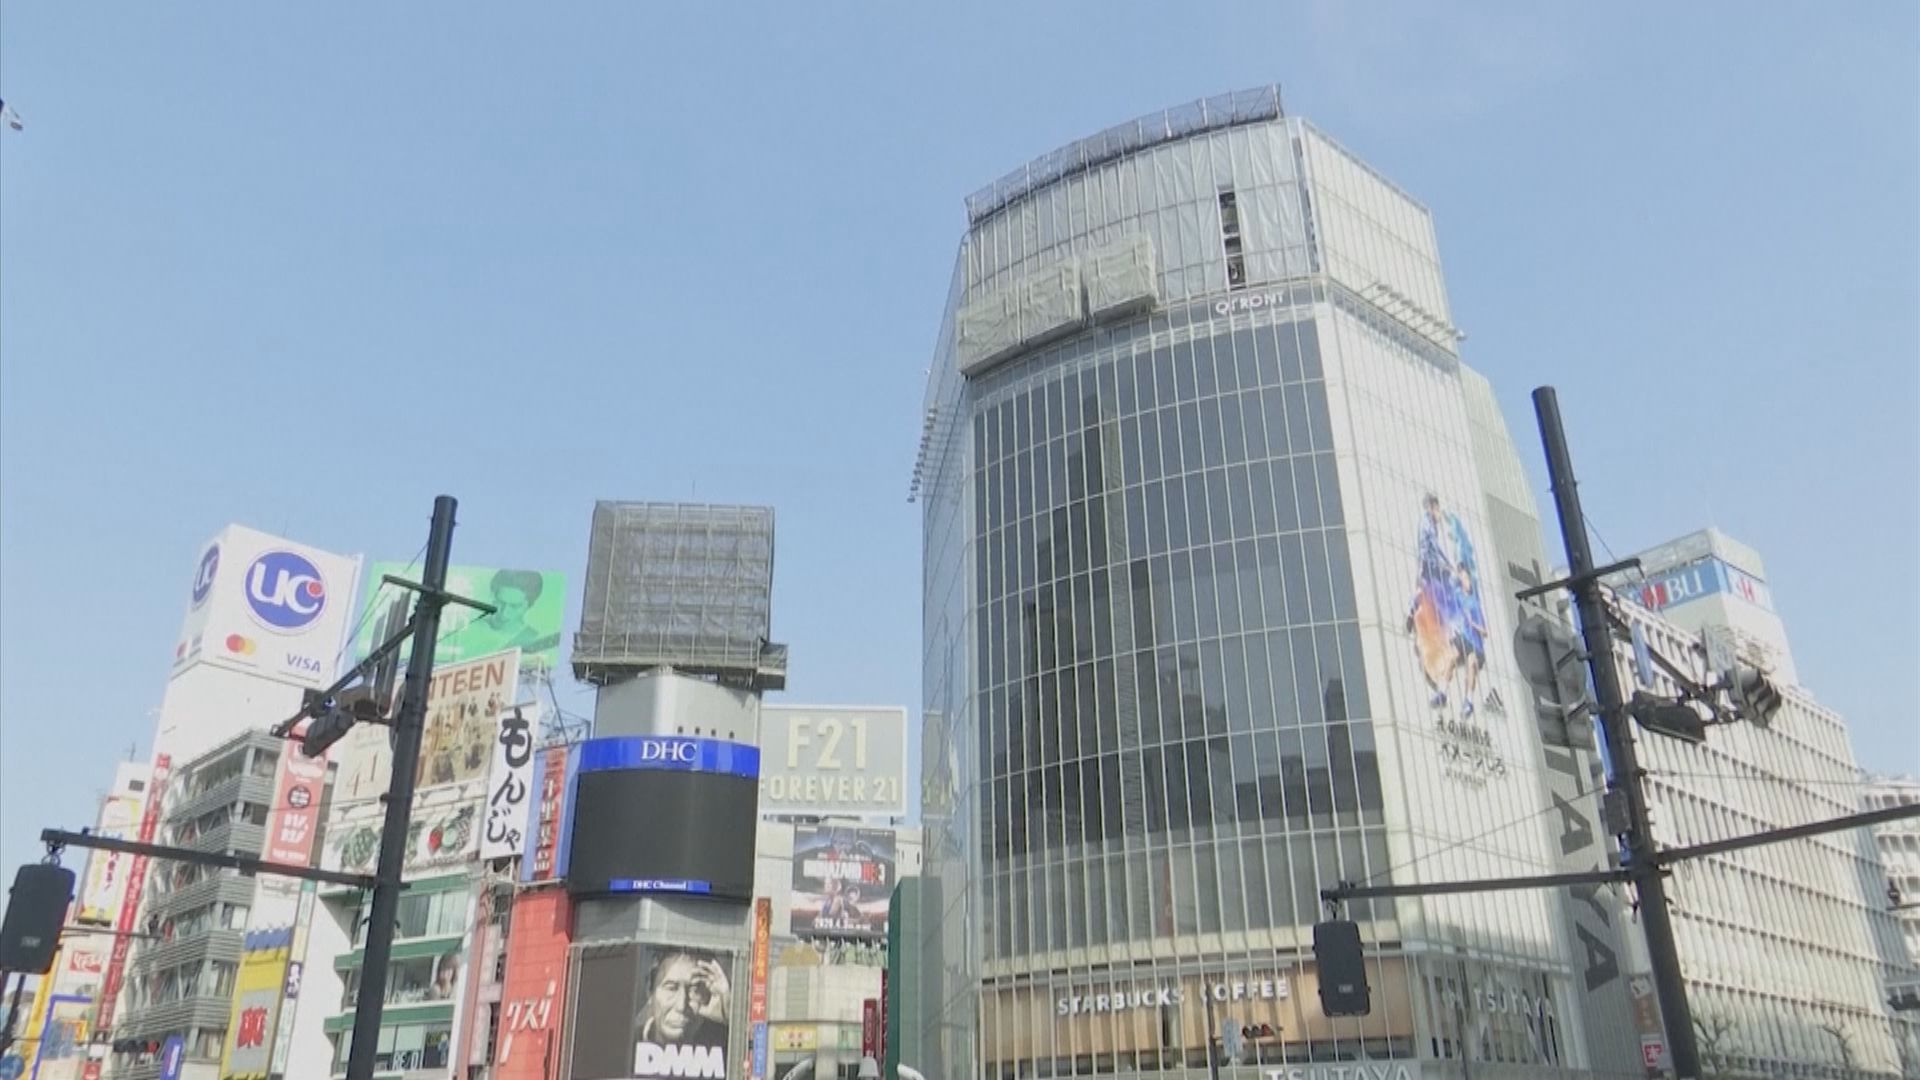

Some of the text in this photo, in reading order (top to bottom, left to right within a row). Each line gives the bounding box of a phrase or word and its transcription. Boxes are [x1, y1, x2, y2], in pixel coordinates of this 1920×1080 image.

[251, 561, 322, 614] UC
[286, 653, 321, 672] VISA
[641, 740, 697, 762] DHC
[787, 716, 868, 771] F21
[490, 706, 533, 852] もんじゃ
[873, 776, 898, 802] 21
[633, 879, 653, 890] DHC
[1057, 986, 1184, 1016] STARBUCKS
[634, 1041, 725, 1079] DMM
